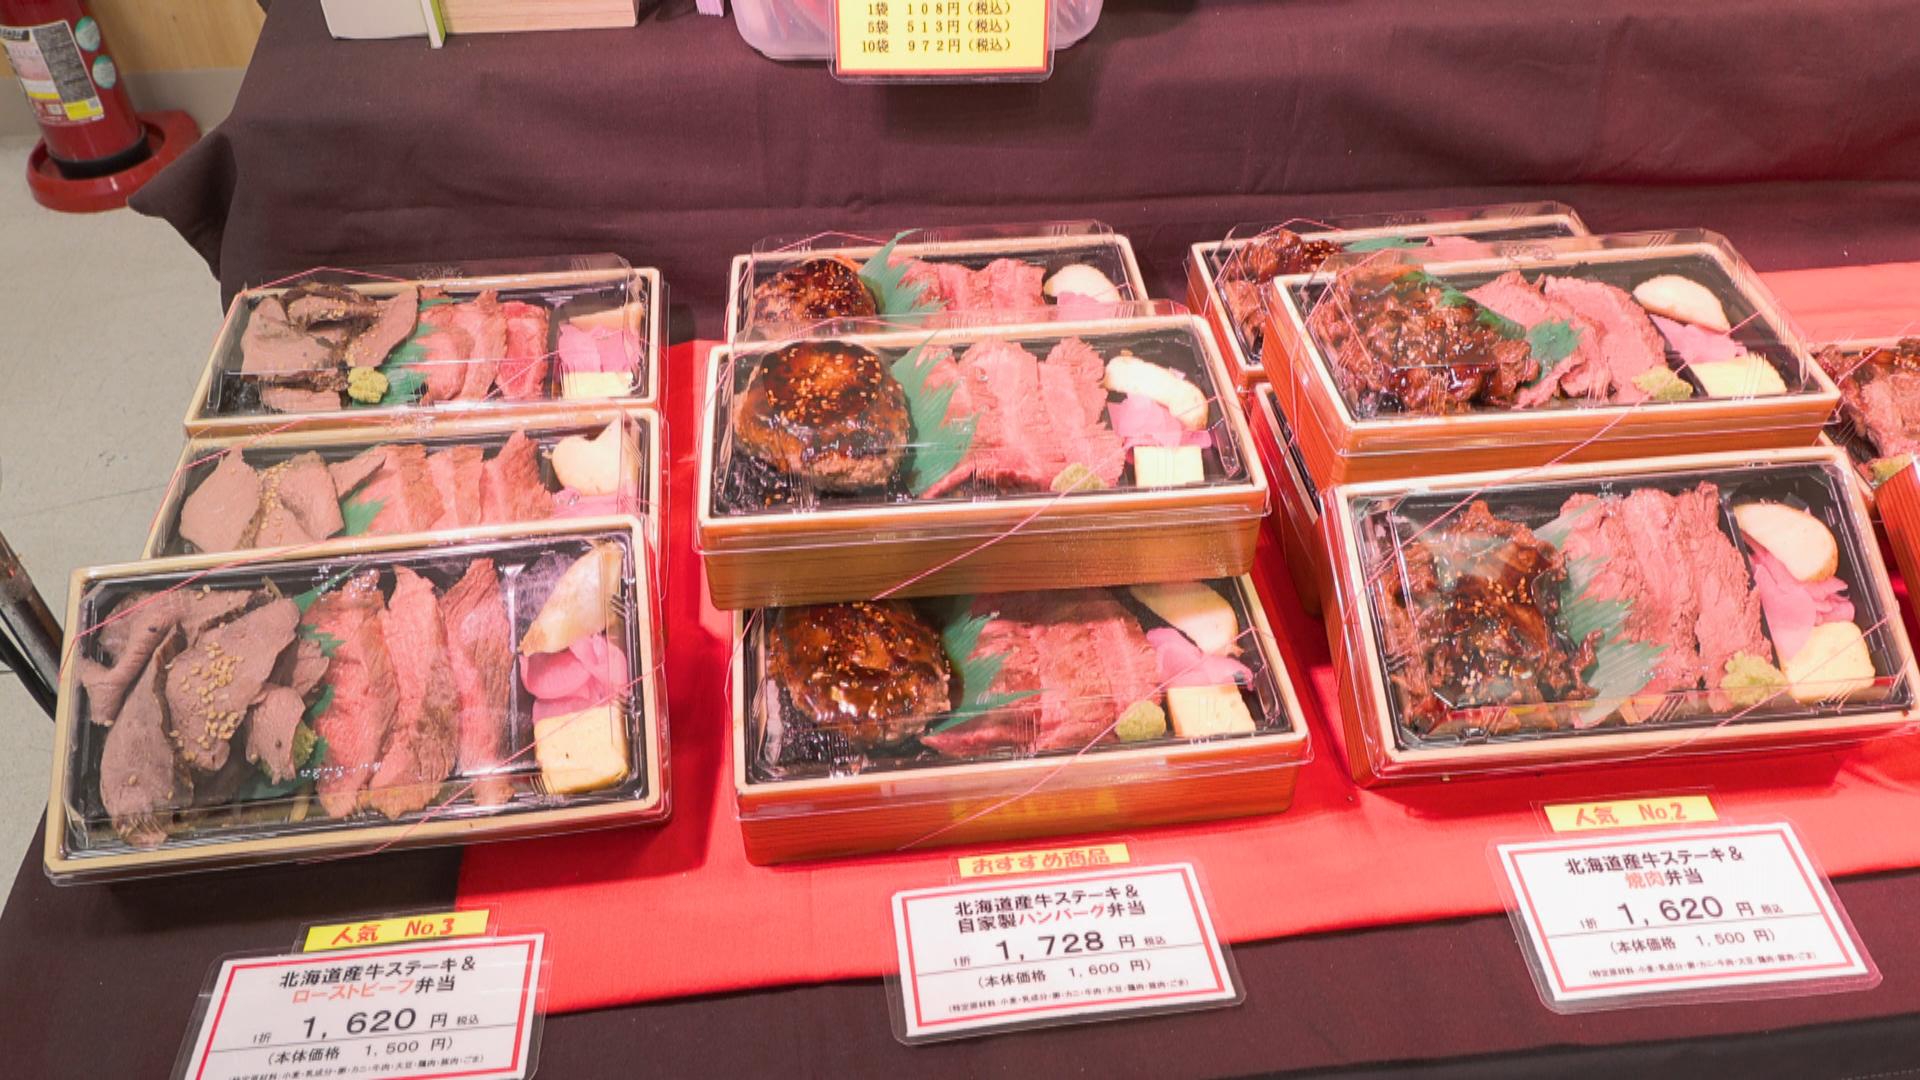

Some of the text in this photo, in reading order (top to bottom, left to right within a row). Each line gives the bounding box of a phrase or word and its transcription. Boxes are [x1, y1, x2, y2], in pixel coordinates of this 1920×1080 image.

[862, 39, 889, 53] 10袋
[1576, 803, 1687, 826] 人気 No.2
[972, 848, 1110, 875] おすすめ商品
[1625, 867, 1704, 890] 焼肉弁当
[957, 900, 1145, 935] 自家製ハンバーグ弁当
[1617, 896, 1724, 927] 1,620
[1737, 901, 1755, 917] 円
[1761, 903, 1784, 914] 税込
[331, 917, 454, 945] 人気 No.3
[995, 931, 1104, 962] 1,728
[1119, 934, 1136, 950] 円
[1144, 935, 1167, 946] 税込
[292, 976, 456, 1004] ローストビーフ弁当
[302, 1008, 417, 1039] 1,620
[430, 1013, 448, 1029] 円
[457, 1014, 479, 1025] 税込
